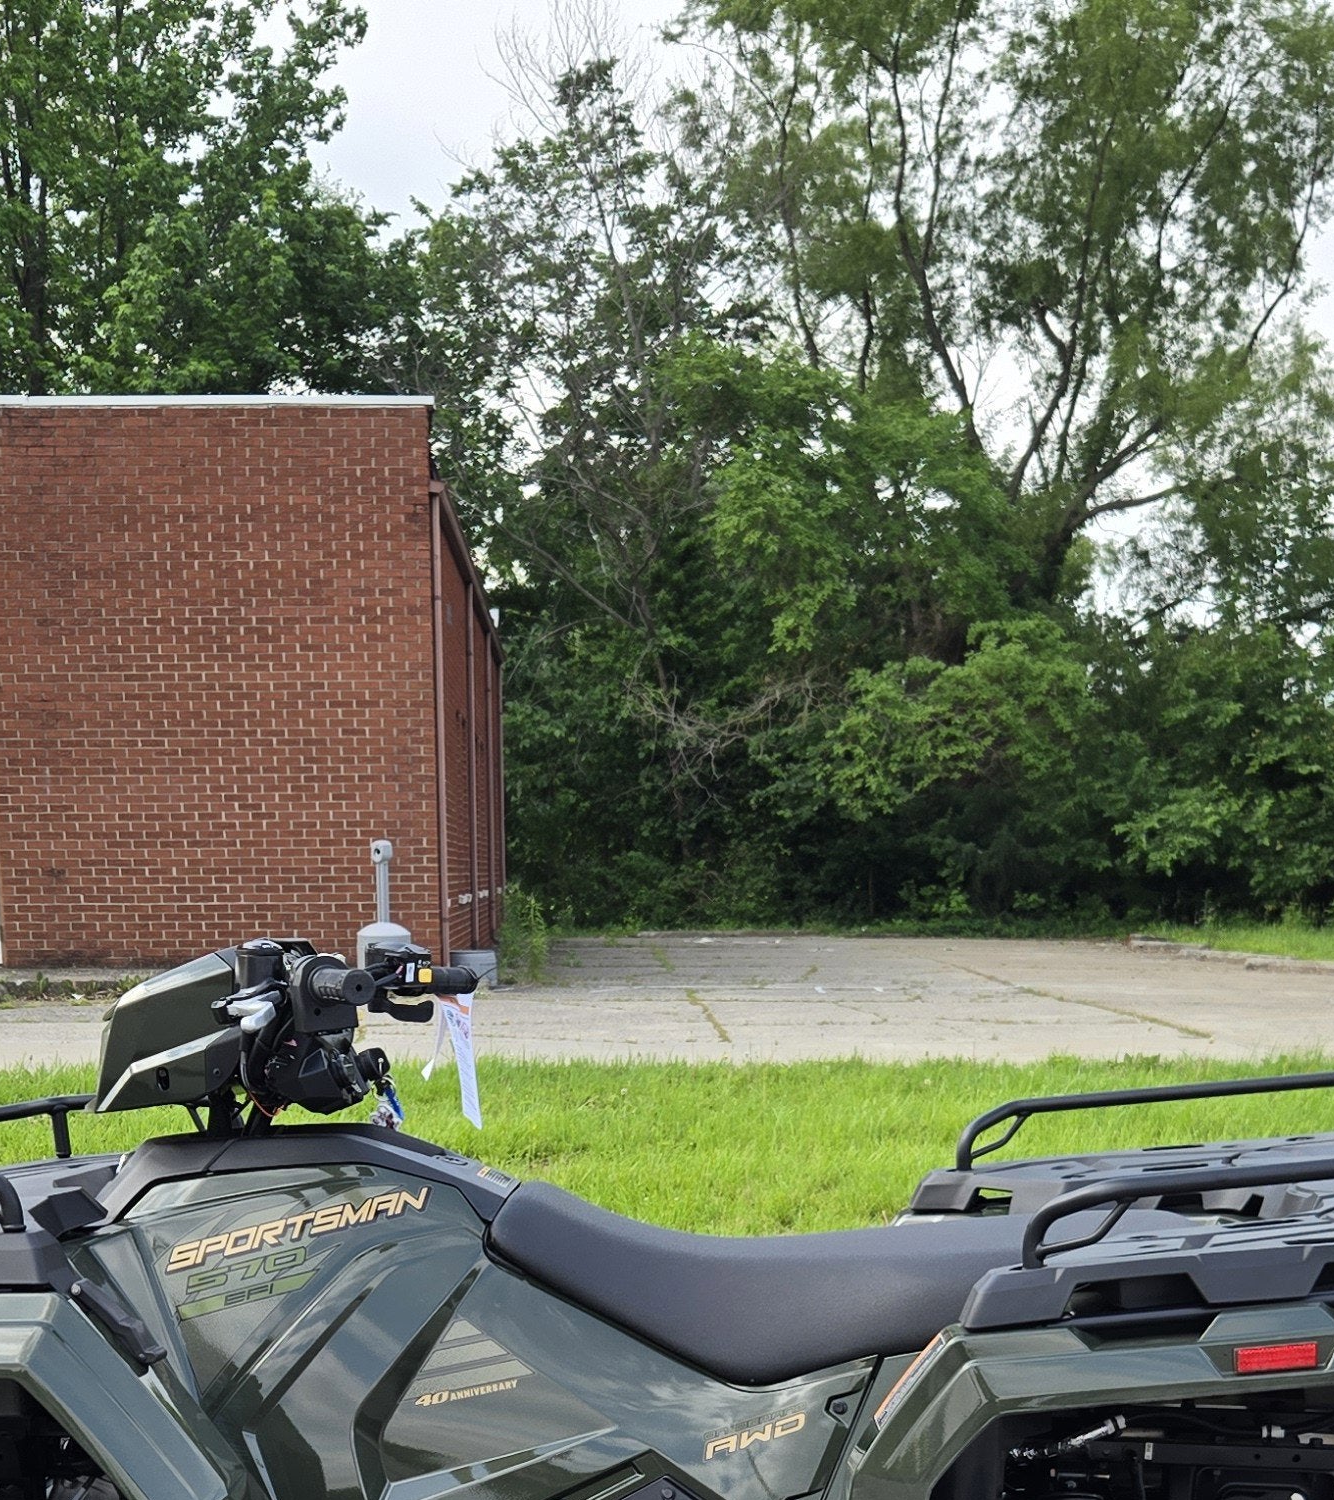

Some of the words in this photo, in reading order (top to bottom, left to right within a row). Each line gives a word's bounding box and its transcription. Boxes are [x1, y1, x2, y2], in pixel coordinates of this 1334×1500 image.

[166, 1186, 432, 1274] SPORTSMAN
[186, 1246, 307, 1295] 570
[224, 1283, 274, 1306] EFI
[414, 1389, 450, 1407] 40
[450, 1379, 518, 1401] ANNIVERSARY
[704, 1411, 806, 1460] AWD
